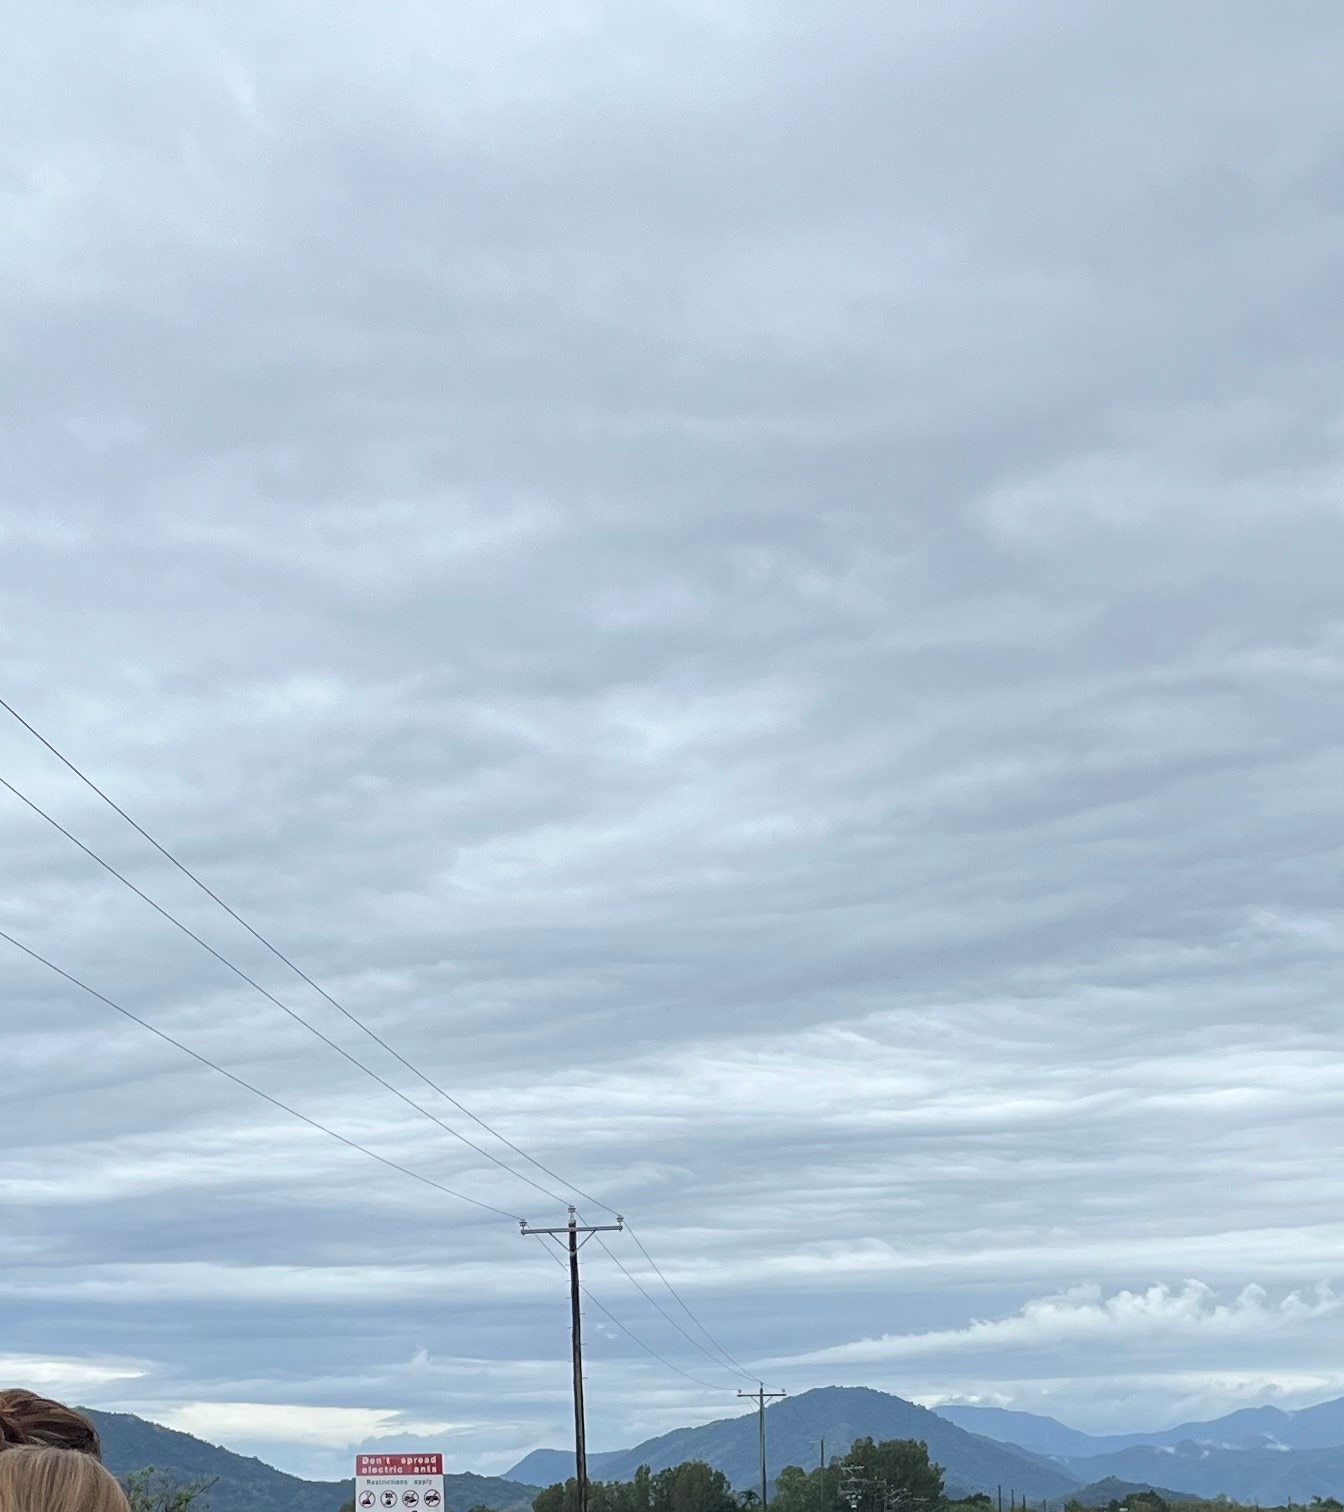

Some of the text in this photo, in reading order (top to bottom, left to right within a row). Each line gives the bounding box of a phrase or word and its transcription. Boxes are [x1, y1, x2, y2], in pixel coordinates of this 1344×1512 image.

[362, 1456, 437, 1465] Don't spread
[362, 1465, 437, 1474] electric ants
[414, 1478, 433, 1486] apply
